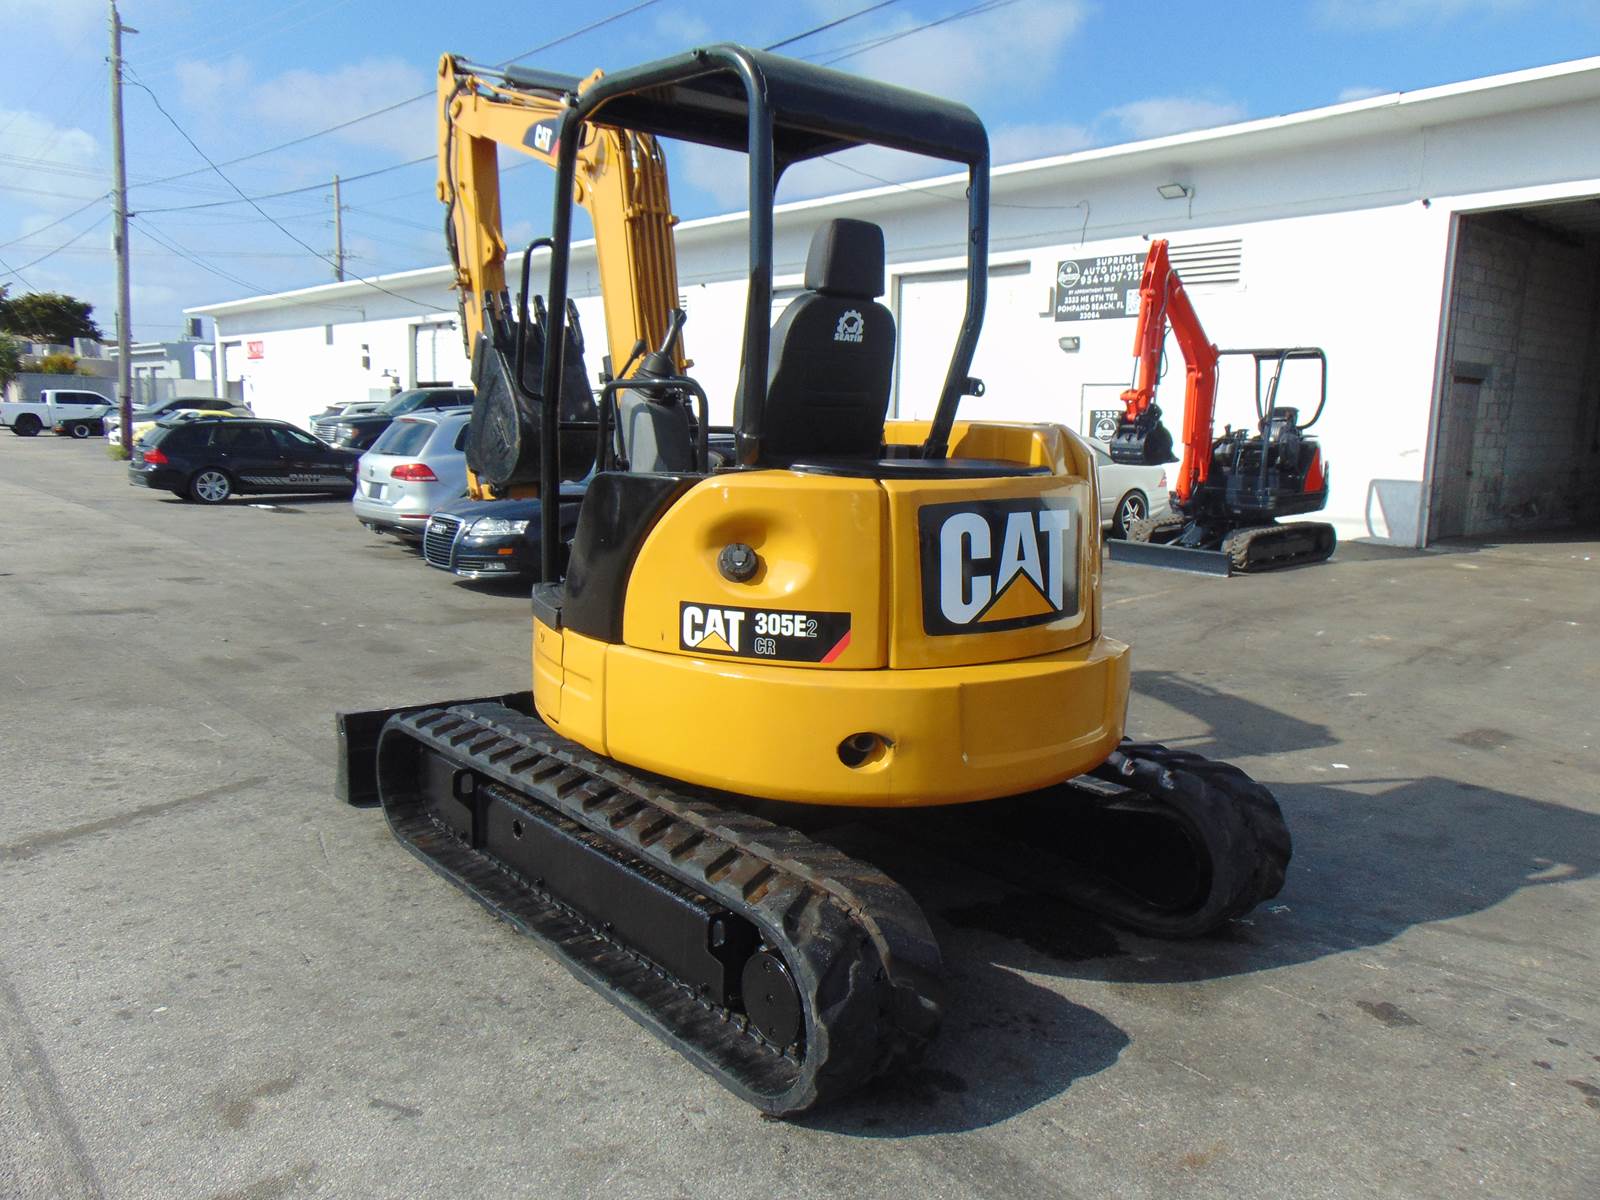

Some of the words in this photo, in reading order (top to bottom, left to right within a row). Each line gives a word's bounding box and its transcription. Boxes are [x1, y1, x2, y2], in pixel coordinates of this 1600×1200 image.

[534, 124, 553, 152] CAT
[1096, 255, 1137, 266] SUPREME
[1083, 266, 1107, 276] AUTO
[1105, 293, 1118, 301] TER
[1057, 303, 1090, 312] POMPANO
[1116, 301, 1124, 309] FL
[1095, 411, 1119, 419] 3333
[289, 473, 321, 482] BMW
[940, 509, 1071, 625] CAT
[683, 606, 746, 653] CAT
[754, 612, 818, 638] 305E2
[754, 637, 776, 655] CR
